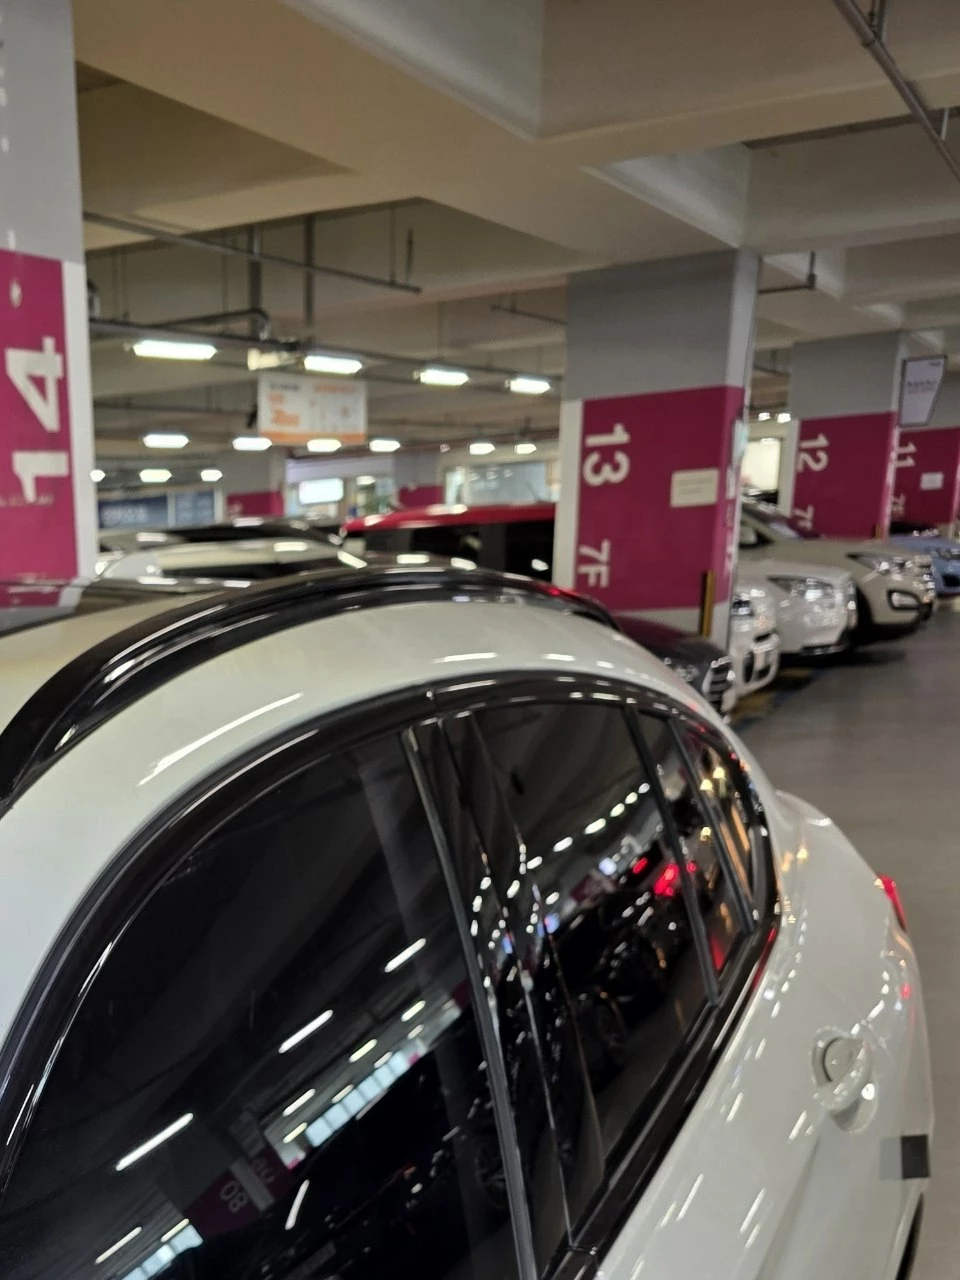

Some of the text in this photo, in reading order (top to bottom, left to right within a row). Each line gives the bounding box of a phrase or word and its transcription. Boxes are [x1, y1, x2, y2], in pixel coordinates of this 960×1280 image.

[4, 335, 70, 503] 14
[583, 422, 631, 487] 13
[797, 433, 829, 473] 12
[577, 538, 611, 588] 7F
